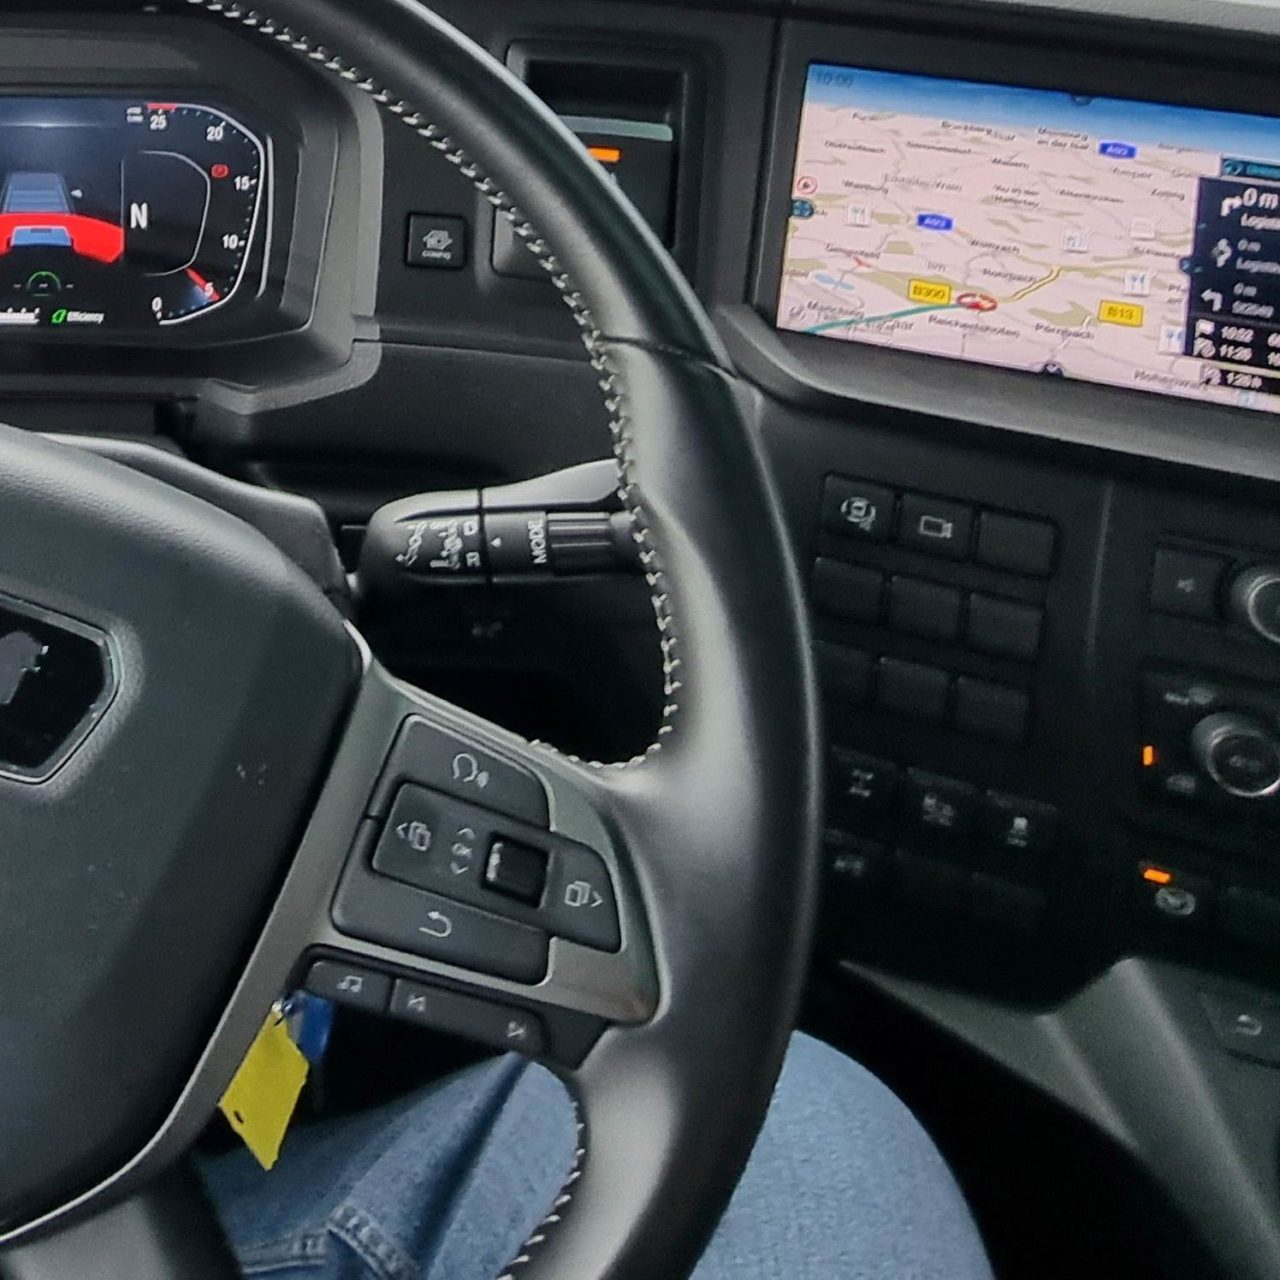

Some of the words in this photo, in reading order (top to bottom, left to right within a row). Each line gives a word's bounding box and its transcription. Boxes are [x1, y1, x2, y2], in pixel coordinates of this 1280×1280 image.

[150, 114, 167, 130] 25
[206, 125, 224, 141] 20
[234, 175, 250, 191] 15
[1243, 187, 1258, 207] 0
[1259, 192, 1279, 210] m
[130, 202, 148, 229] N
[222, 234, 239, 249] 10
[1237, 238, 1249, 251] 0
[204, 282, 214, 297] 5
[912, 283, 947, 301] B300
[1233, 282, 1244, 296] 0
[151, 296, 163, 312] 0
[66, 310, 105, 325] Efficiency
[1106, 305, 1135, 322] B13
[527, 517, 548, 565] MODE
